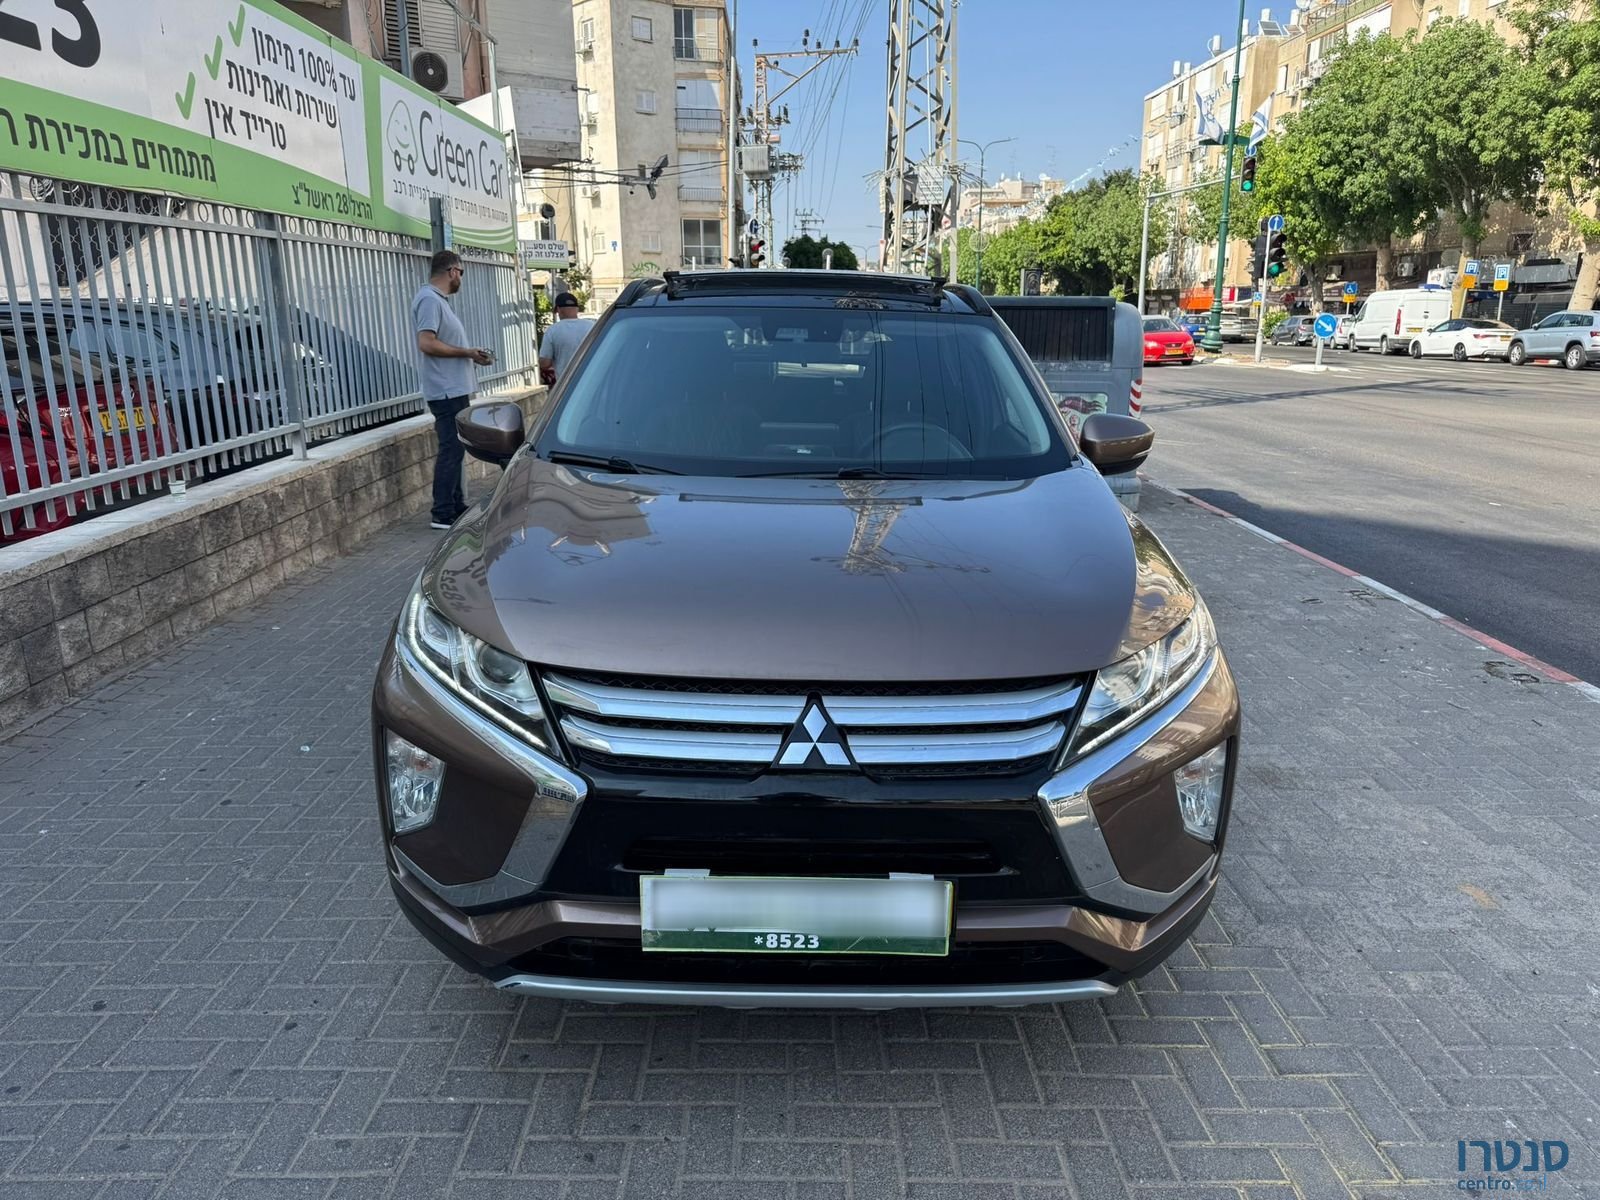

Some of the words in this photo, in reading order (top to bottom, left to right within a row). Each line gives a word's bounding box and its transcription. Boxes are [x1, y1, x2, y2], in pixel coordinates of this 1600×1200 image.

[252, 27, 296, 72] מימון
[225, 59, 292, 112] ואמינות
[299, 48, 338, 93] 100%
[339, 72, 356, 101] עד
[204, 97, 237, 139] אין
[295, 88, 337, 128] שירות
[24, 112, 129, 166] במכירת
[239, 109, 287, 150] טרייד
[131, 137, 217, 183] מתמחים
[419, 110, 478, 190] Green
[479, 139, 503, 199] Car
[335, 191, 349, 215] 28
[349, 193, 373, 220] הרצל
[392, 179, 407, 195] רכב
[544, 250, 565, 258] אצלנו
[547, 242, 565, 250] שלם
